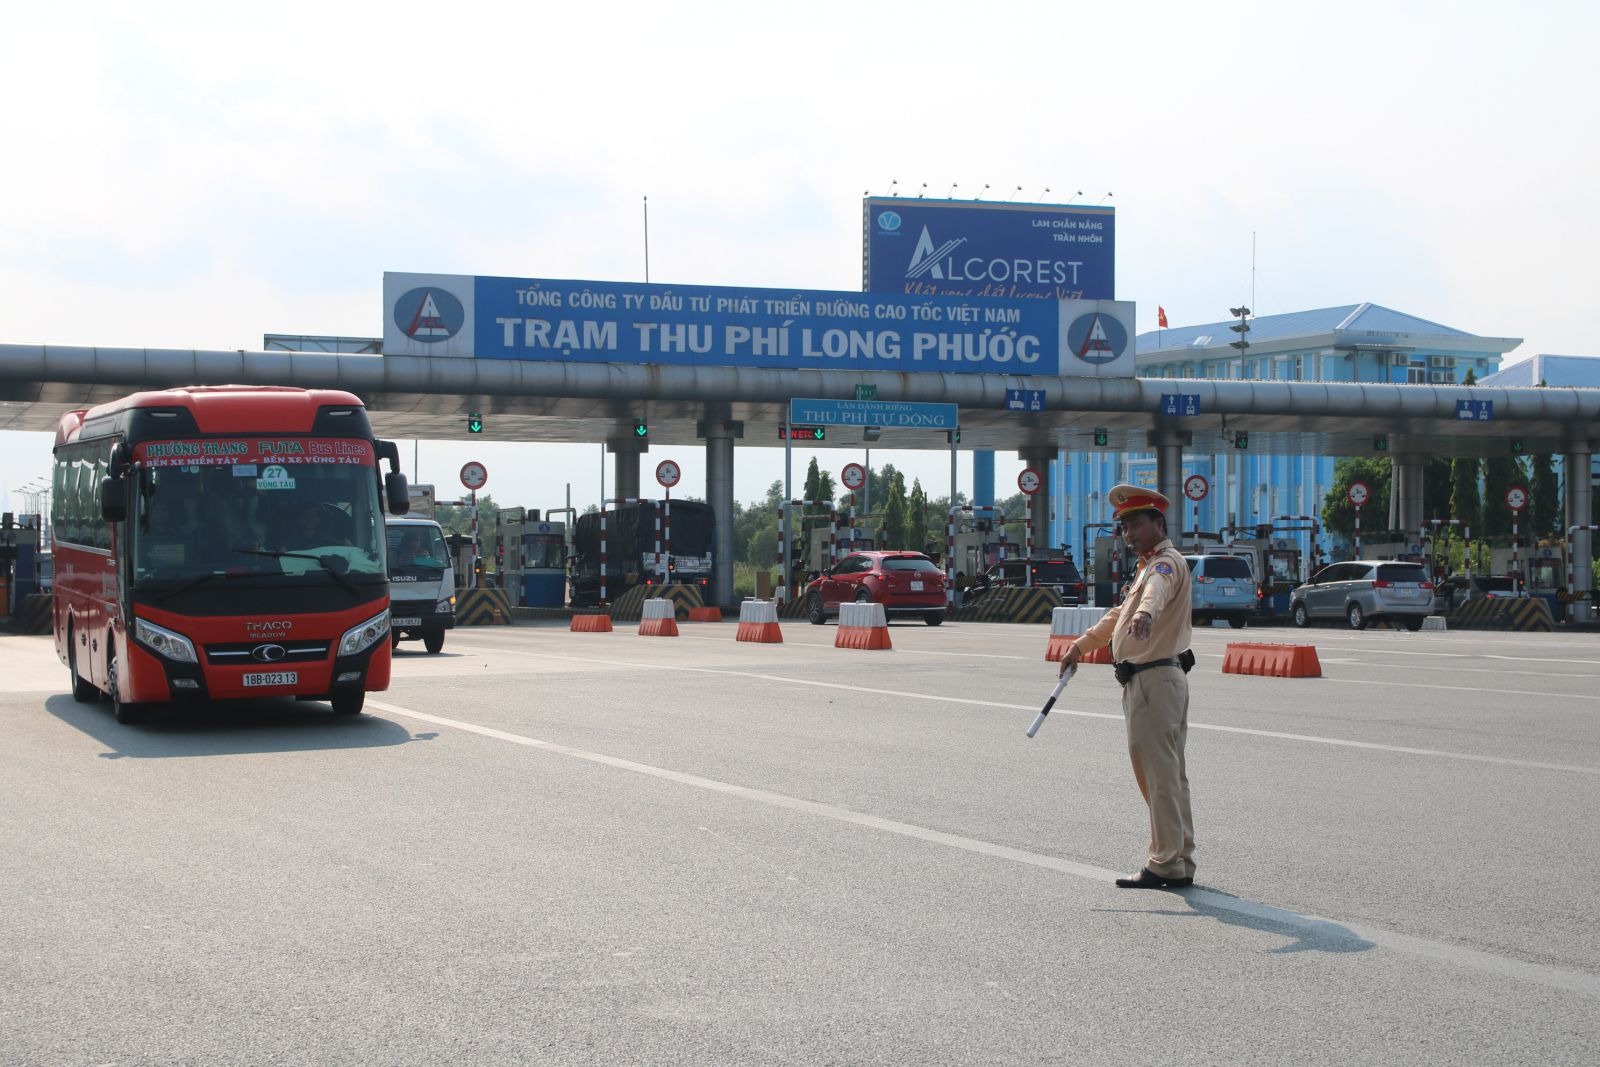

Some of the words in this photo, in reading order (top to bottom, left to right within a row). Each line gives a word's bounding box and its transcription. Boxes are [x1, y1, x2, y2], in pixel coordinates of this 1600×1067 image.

[1032, 219, 1050, 228] LAM
[905, 224, 1083, 285] ALCOREST
[515, 283, 562, 307] TỔNG
[568, 288, 616, 309] CÔNG
[622, 294, 644, 310] TY
[650, 290, 682, 311] ĐẦU
[689, 295, 712, 313] TƯ
[717, 295, 759, 314] PHÁT
[764, 293, 810, 316] TRIỂN
[815, 299, 869, 318] ĐƯỜNG
[875, 304, 906, 320] CAO
[911, 301, 942, 321] TỐC
[947, 303, 980, 325] VIỆT
[984, 308, 1021, 323] NAM
[495, 317, 618, 356] TRẠM
[632, 322, 713, 354] THU
[725, 319, 795, 357] PHÍ
[802, 328, 901, 360] LONG
[913, 326, 1041, 364] PHƯỚC
[803, 410, 837, 422] THU
[842, 409, 868, 423] PHÍ
[899, 412, 946, 426] ĐỘNG
[781, 430, 798, 438] LN
[146, 441, 200, 457] PHƯƠNG
[202, 442, 248, 455] TRANG
[258, 441, 304, 454] FUTA
[308, 441, 333, 454] Bus
[335, 442, 366, 455] Lines
[267, 468, 282, 479] 27
[245, 621, 292, 631] THACO
[246, 673, 296, 685] 18B-023.13
